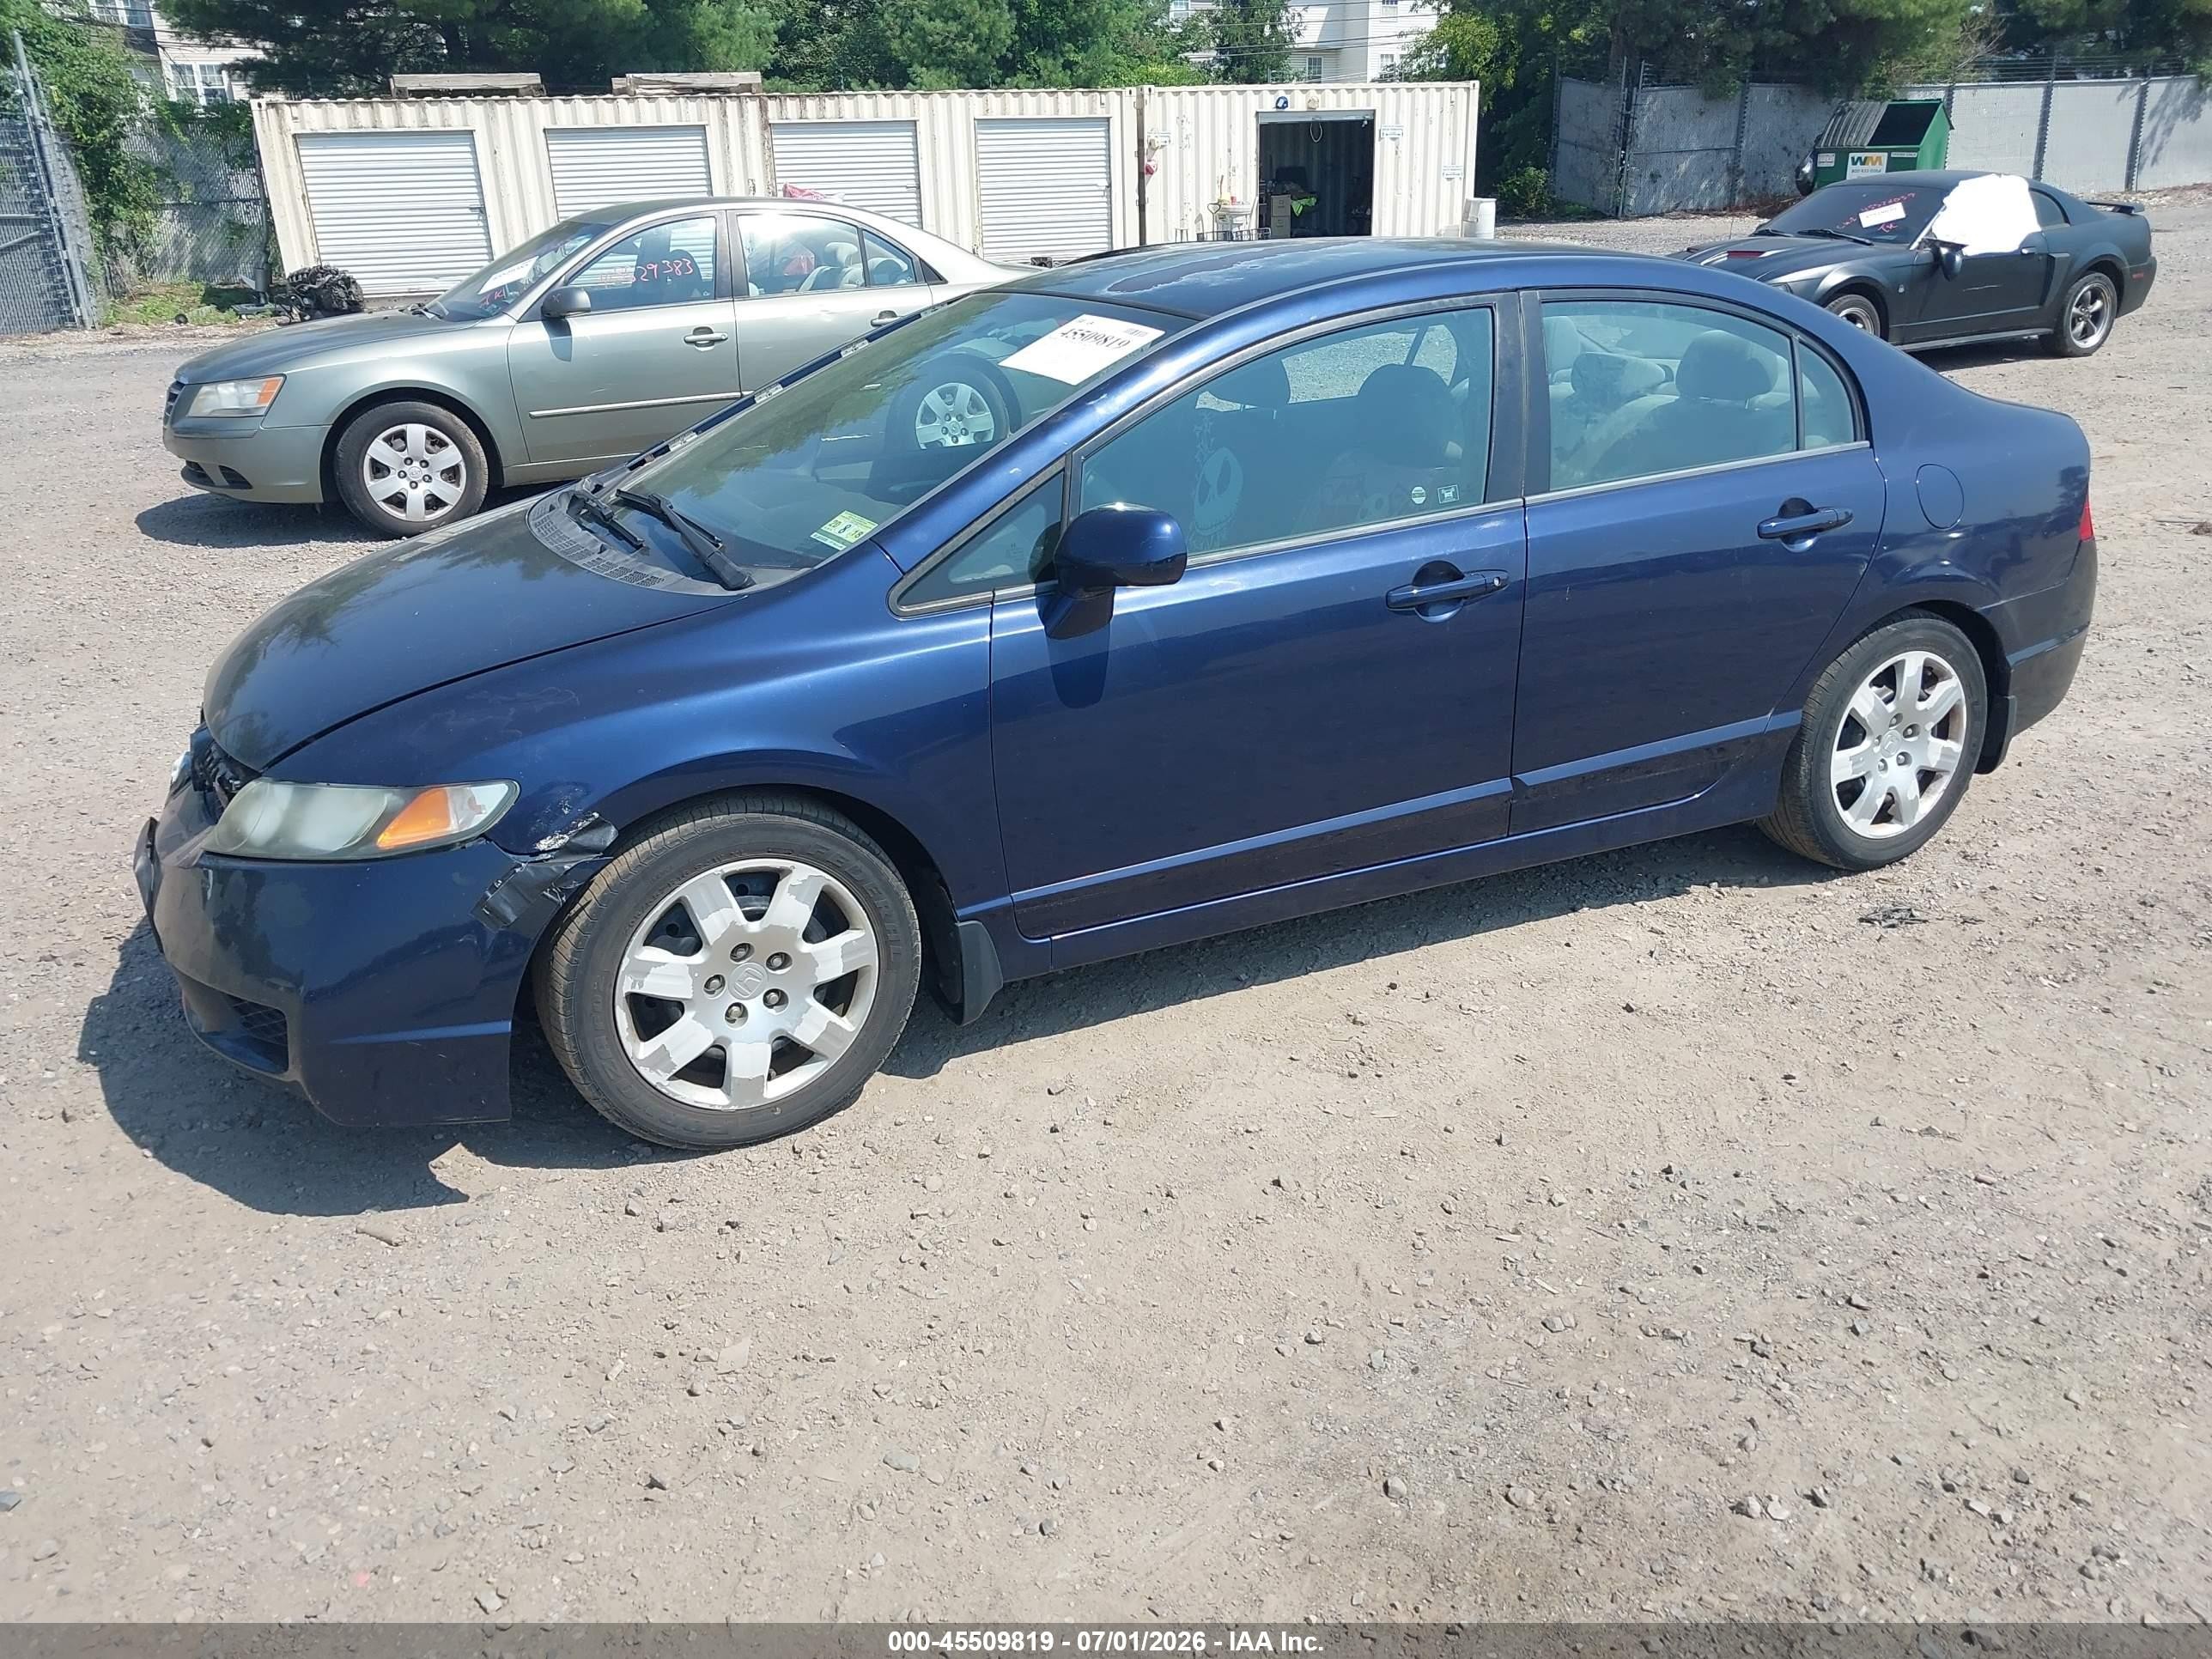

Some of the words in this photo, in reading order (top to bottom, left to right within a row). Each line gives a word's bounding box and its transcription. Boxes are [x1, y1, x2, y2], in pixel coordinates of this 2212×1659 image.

[1850, 155, 1883, 166] WM
[1059, 328, 1132, 349] 45509819
[837, 524, 852, 534] 8
